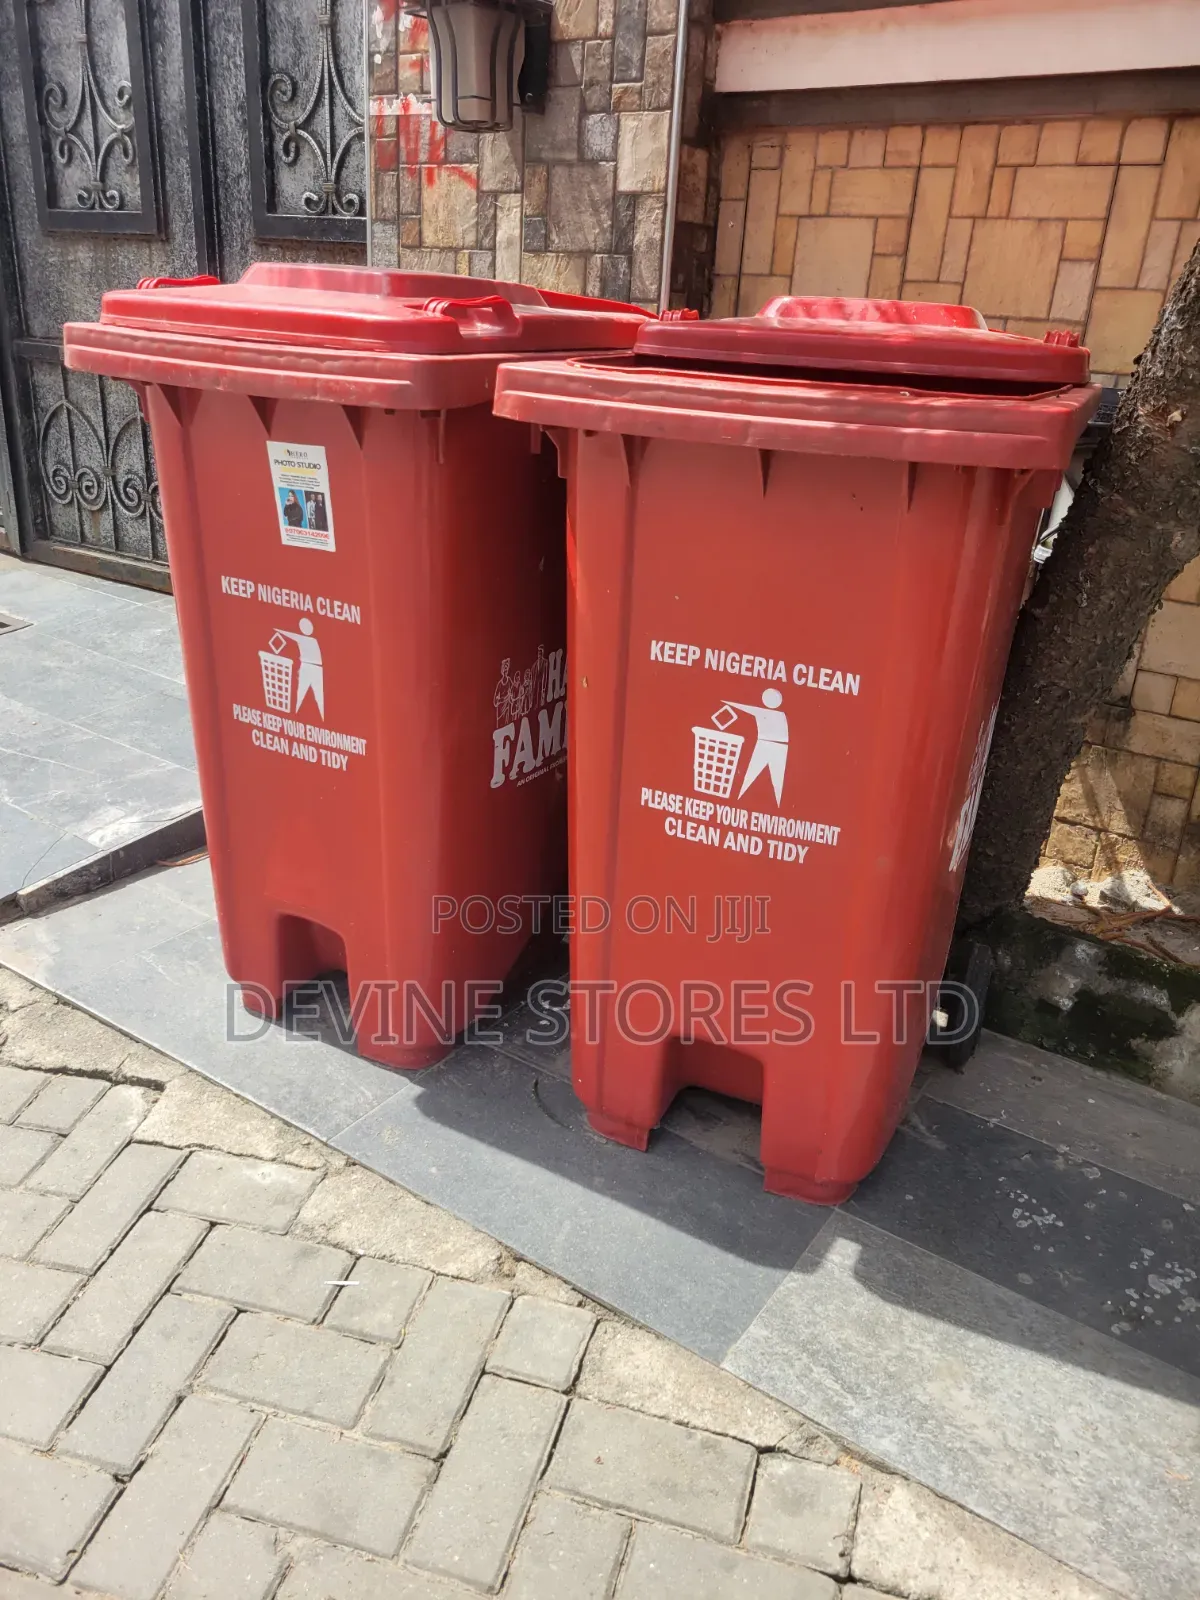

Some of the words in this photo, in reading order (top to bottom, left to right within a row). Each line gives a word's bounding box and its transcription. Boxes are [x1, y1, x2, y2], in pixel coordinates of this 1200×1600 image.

[273, 458, 296, 468] PHOTO
[296, 461, 322, 471] STUDIO
[220, 575, 255, 599] KEEP
[257, 583, 314, 613] NIGERIA
[316, 596, 361, 625] CLEAN
[650, 639, 701, 667] KEEP
[704, 648, 787, 683] NIGERIA
[792, 663, 861, 696] CLEAN
[232, 703, 262, 728] PLEASE
[262, 711, 283, 733] KEEP
[282, 717, 306, 740] YOUR
[306, 724, 367, 756] ENVIRONMENT
[251, 728, 290, 756] CLEAN
[291, 741, 318, 763] AND
[319, 748, 349, 771] TIDY
[640, 786, 684, 815] PLEASE
[684, 797, 715, 821] KEEP
[715, 804, 749, 830] YOUR
[750, 811, 841, 846] ENVIRONMENT
[664, 816, 721, 847] CLEAN
[723, 831, 763, 856] AND
[767, 839, 810, 864] TIDY
